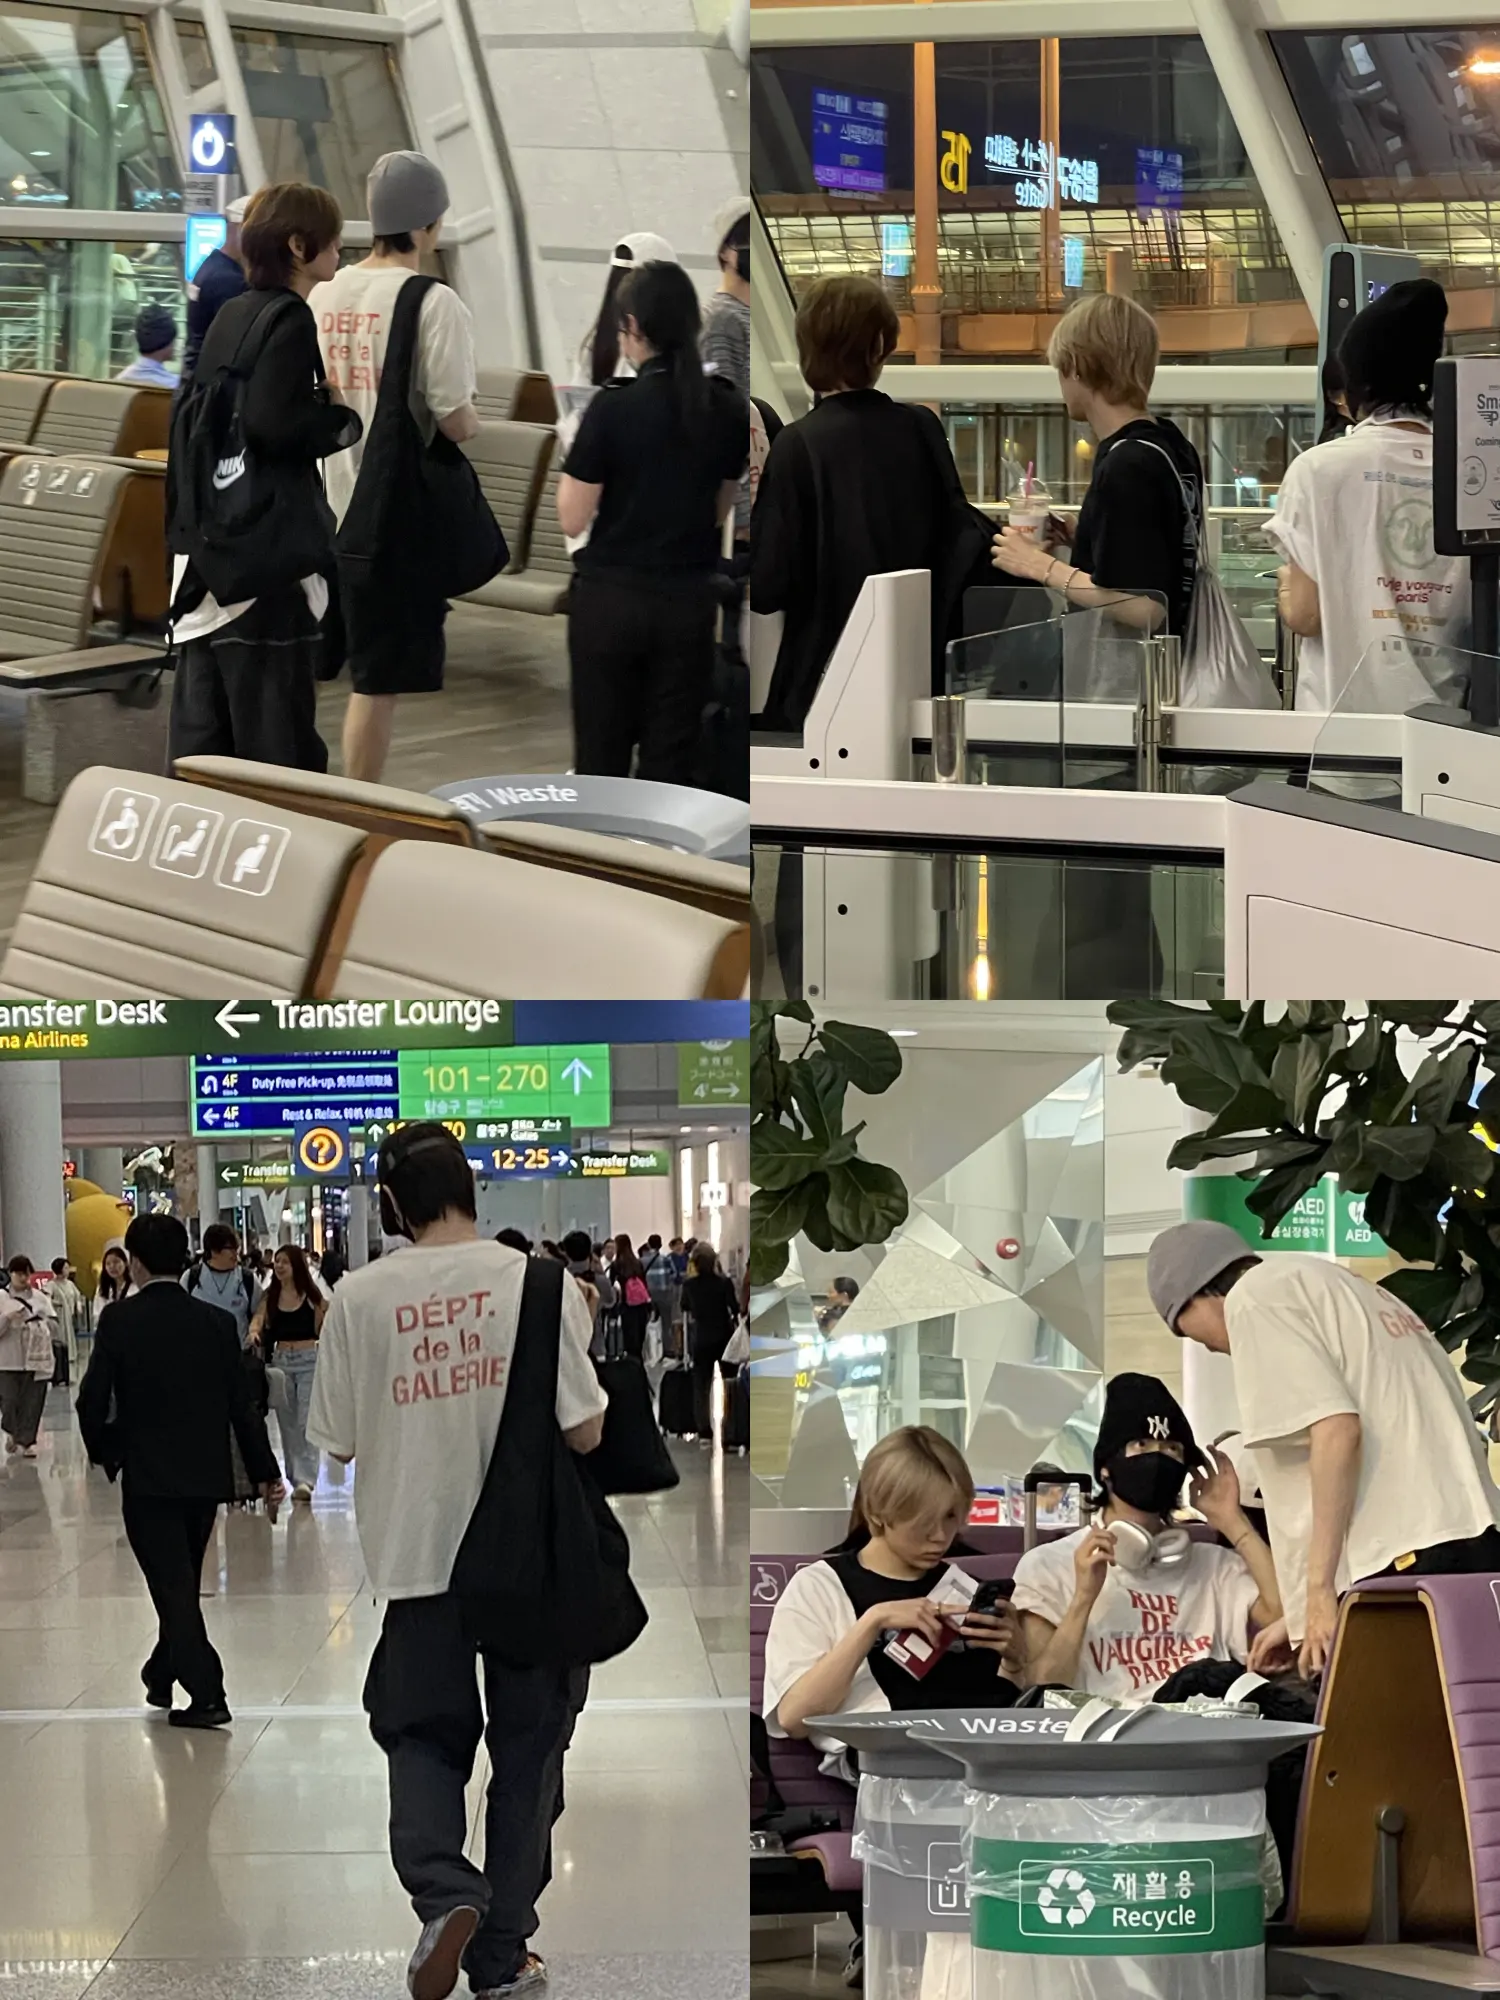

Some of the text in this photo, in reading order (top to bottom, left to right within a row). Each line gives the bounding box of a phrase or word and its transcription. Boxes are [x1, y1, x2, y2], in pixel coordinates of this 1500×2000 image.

[486, 784, 579, 806] Waste
[96, 1000, 168, 1025] Desk
[271, 1000, 500, 1033] Transfer Lounge
[24, 1030, 89, 1048] Airlines
[222, 1073, 238, 1088] 4F
[252, 1077, 275, 1092] Duty
[422, 1065, 470, 1093] 101
[496, 1063, 548, 1091] 270
[223, 1106, 239, 1120] 4F
[242, 1163, 289, 1178] Transfer
[491, 1148, 550, 1171] 12-25
[581, 1154, 658, 1169] Transfer Desk
[1292, 1198, 1326, 1216] AED
[1344, 1229, 1372, 1243] AED
[395, 1291, 496, 1334] DÉPT.
[412, 1327, 481, 1366] de la
[391, 1356, 508, 1408] GALERIE
[1126, 1588, 1179, 1616] RUE
[1141, 1610, 1174, 1635] DE
[959, 1717, 1068, 1735] Waste
[1112, 1870, 1196, 1902] 재활용
[1112, 1904, 1196, 1932] Recycle
